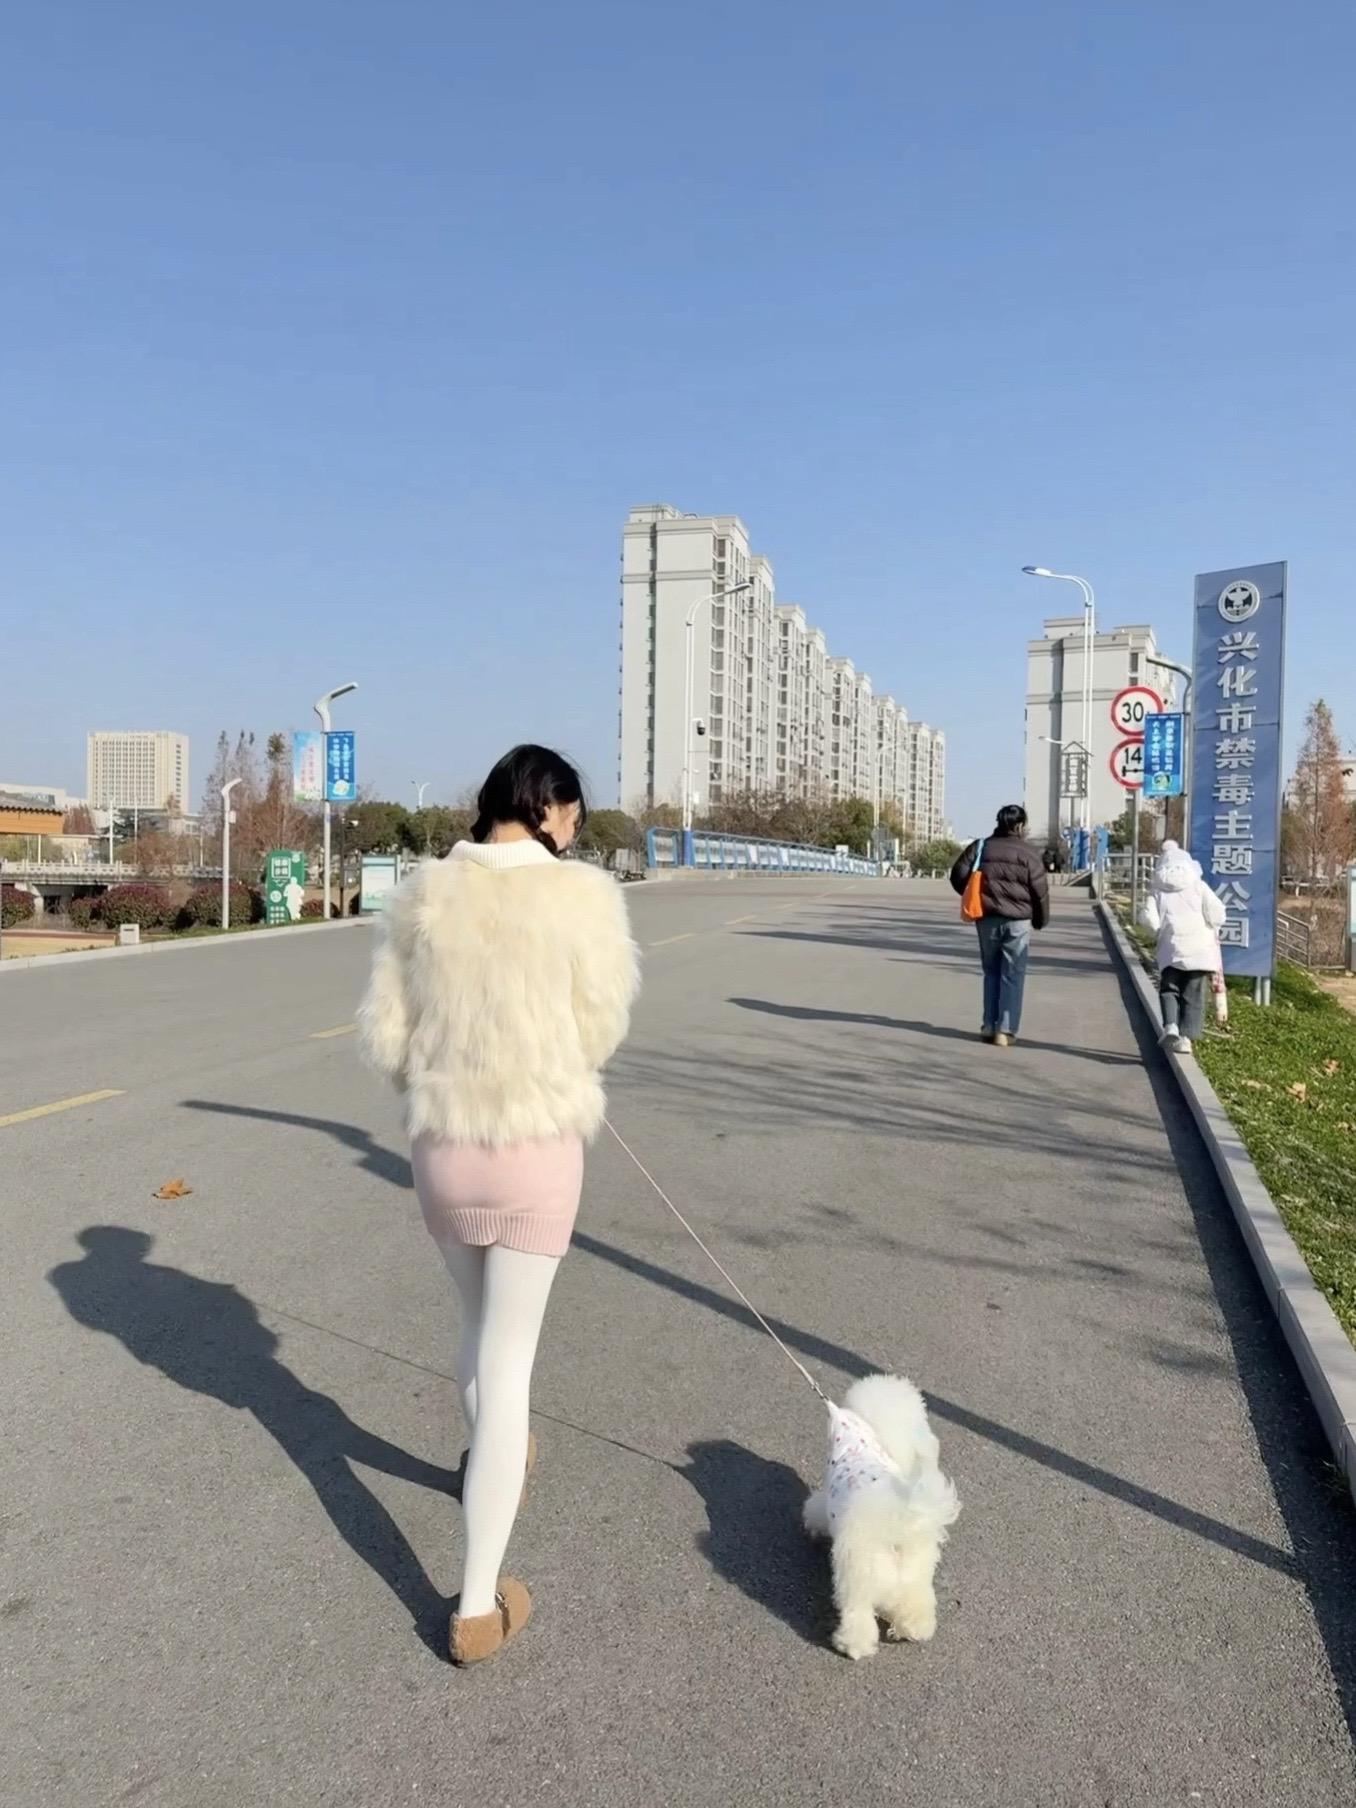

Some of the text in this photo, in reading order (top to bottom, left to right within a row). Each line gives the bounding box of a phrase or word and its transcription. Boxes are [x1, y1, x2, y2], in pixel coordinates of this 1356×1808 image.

[1121, 701, 1144, 723] 30
[1124, 747, 1142, 764] 14
[1211, 632, 1260, 948] 兴化市禁毒主题公园
